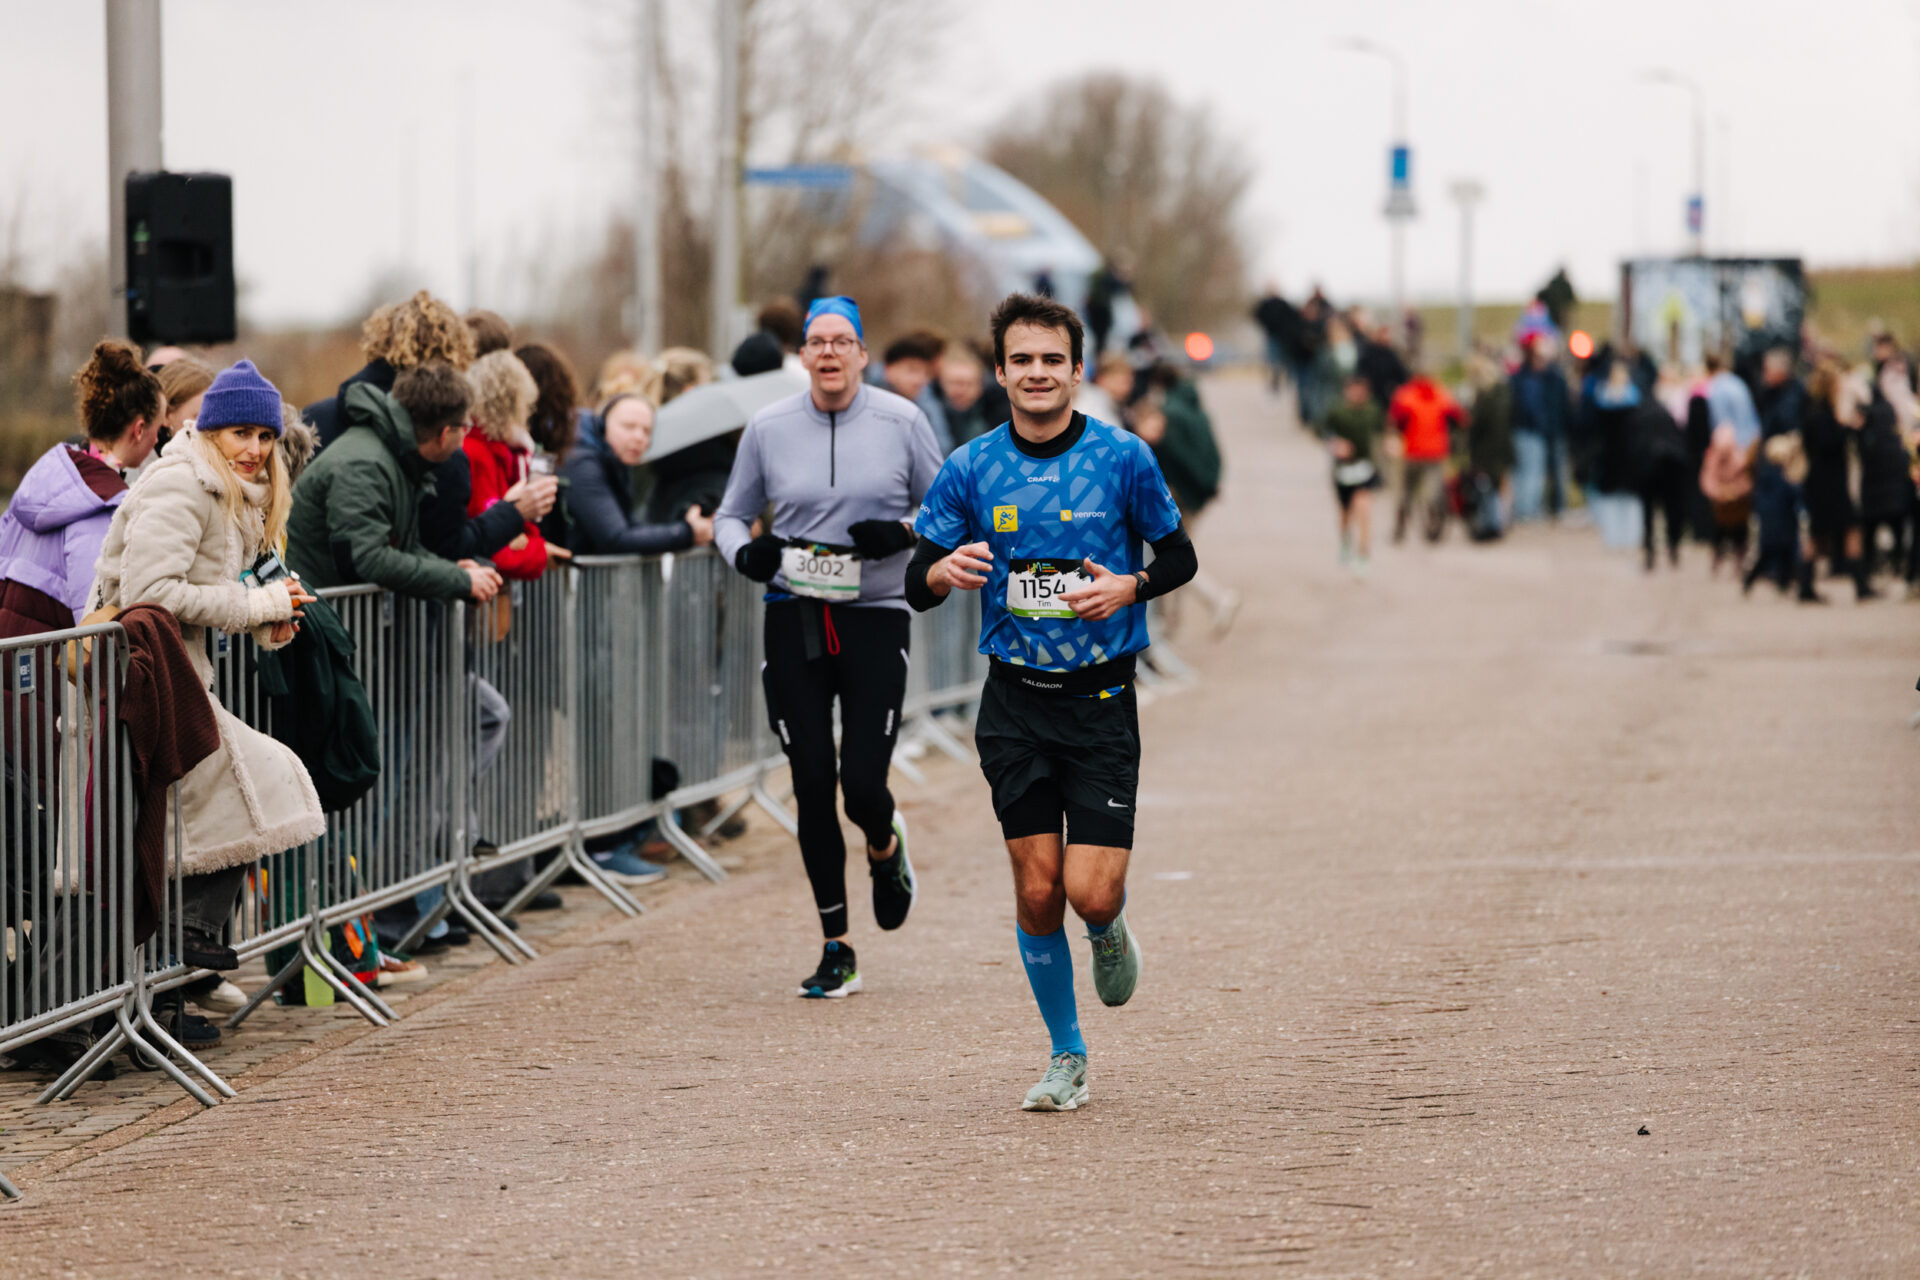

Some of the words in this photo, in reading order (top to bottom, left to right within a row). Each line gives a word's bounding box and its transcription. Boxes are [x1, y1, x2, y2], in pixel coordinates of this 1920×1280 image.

[1073, 511, 1107, 519] venrooy
[796, 555, 845, 577] 3002
[1019, 579, 1066, 599] 1154
[1037, 600, 1052, 608] Tim
[1021, 677, 1063, 689] SALOMON
